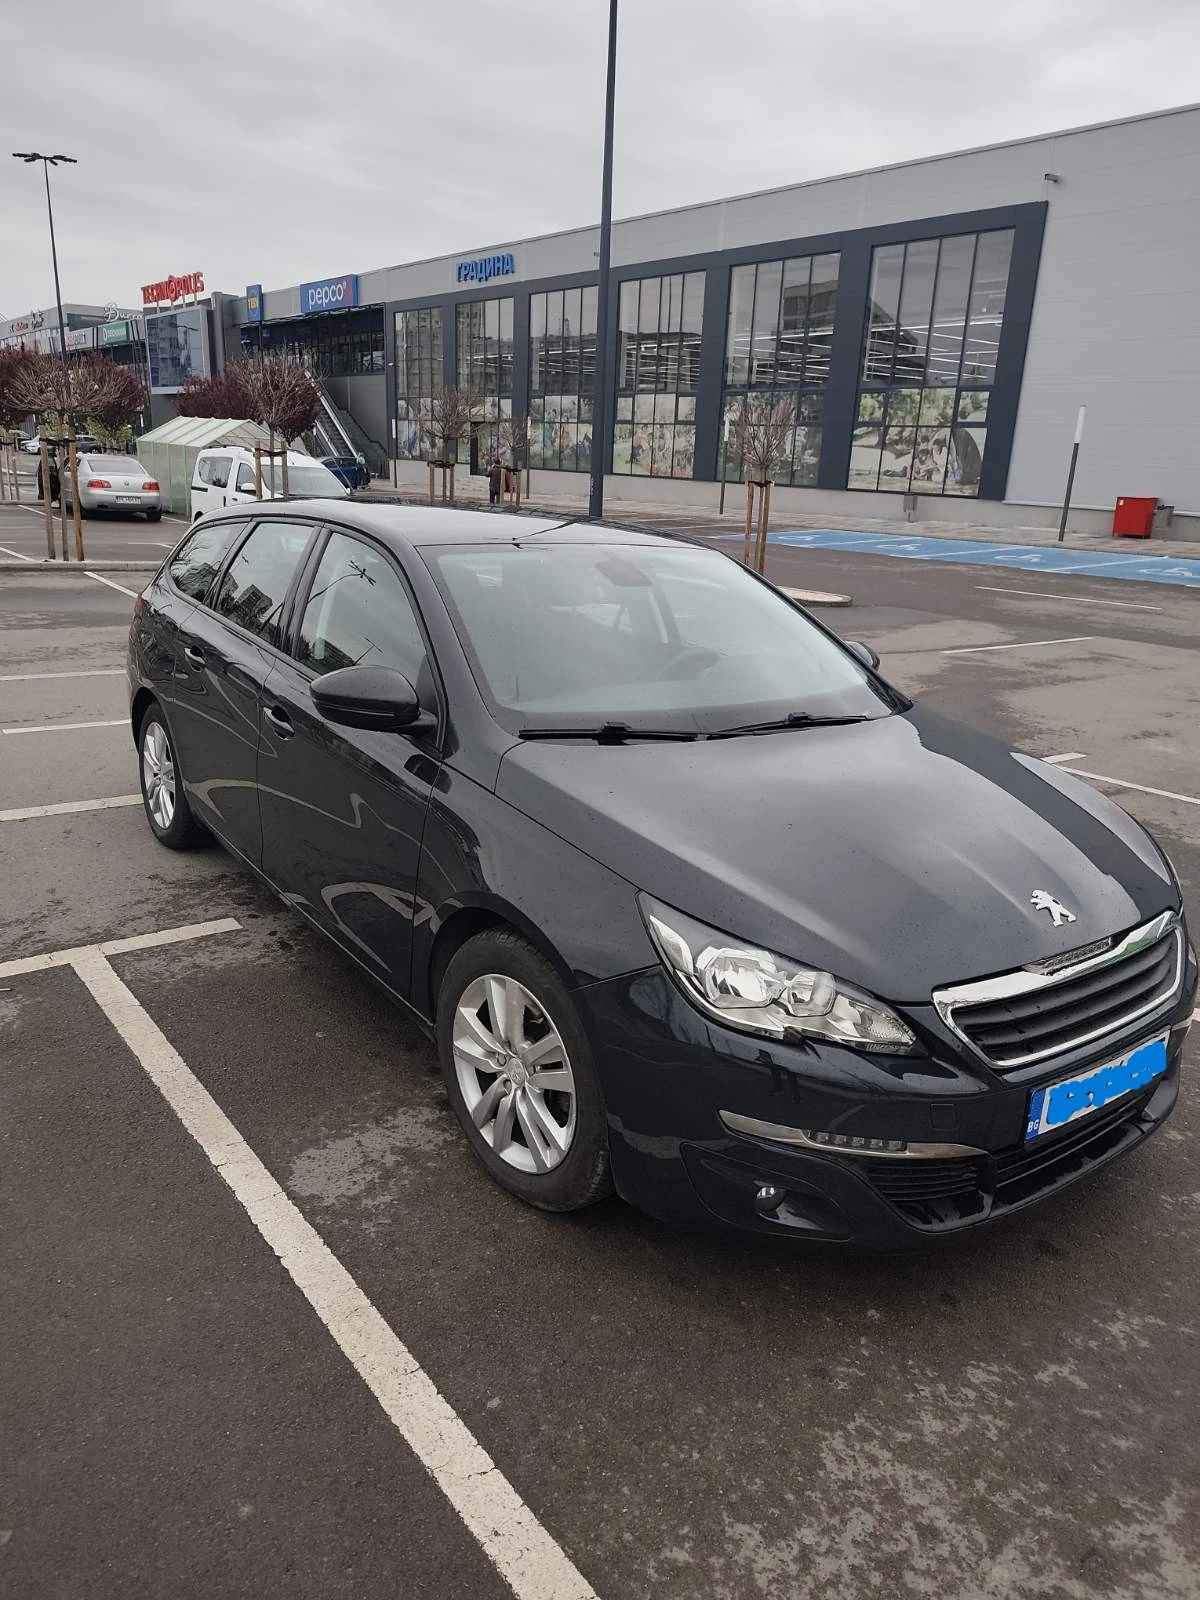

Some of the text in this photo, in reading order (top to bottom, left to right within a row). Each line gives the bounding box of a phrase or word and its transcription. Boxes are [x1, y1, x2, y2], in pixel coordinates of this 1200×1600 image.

[457, 253, 514, 282] ГРАДИНА
[308, 283, 344, 310] pepco
[1027, 1119, 1040, 1132] BG
